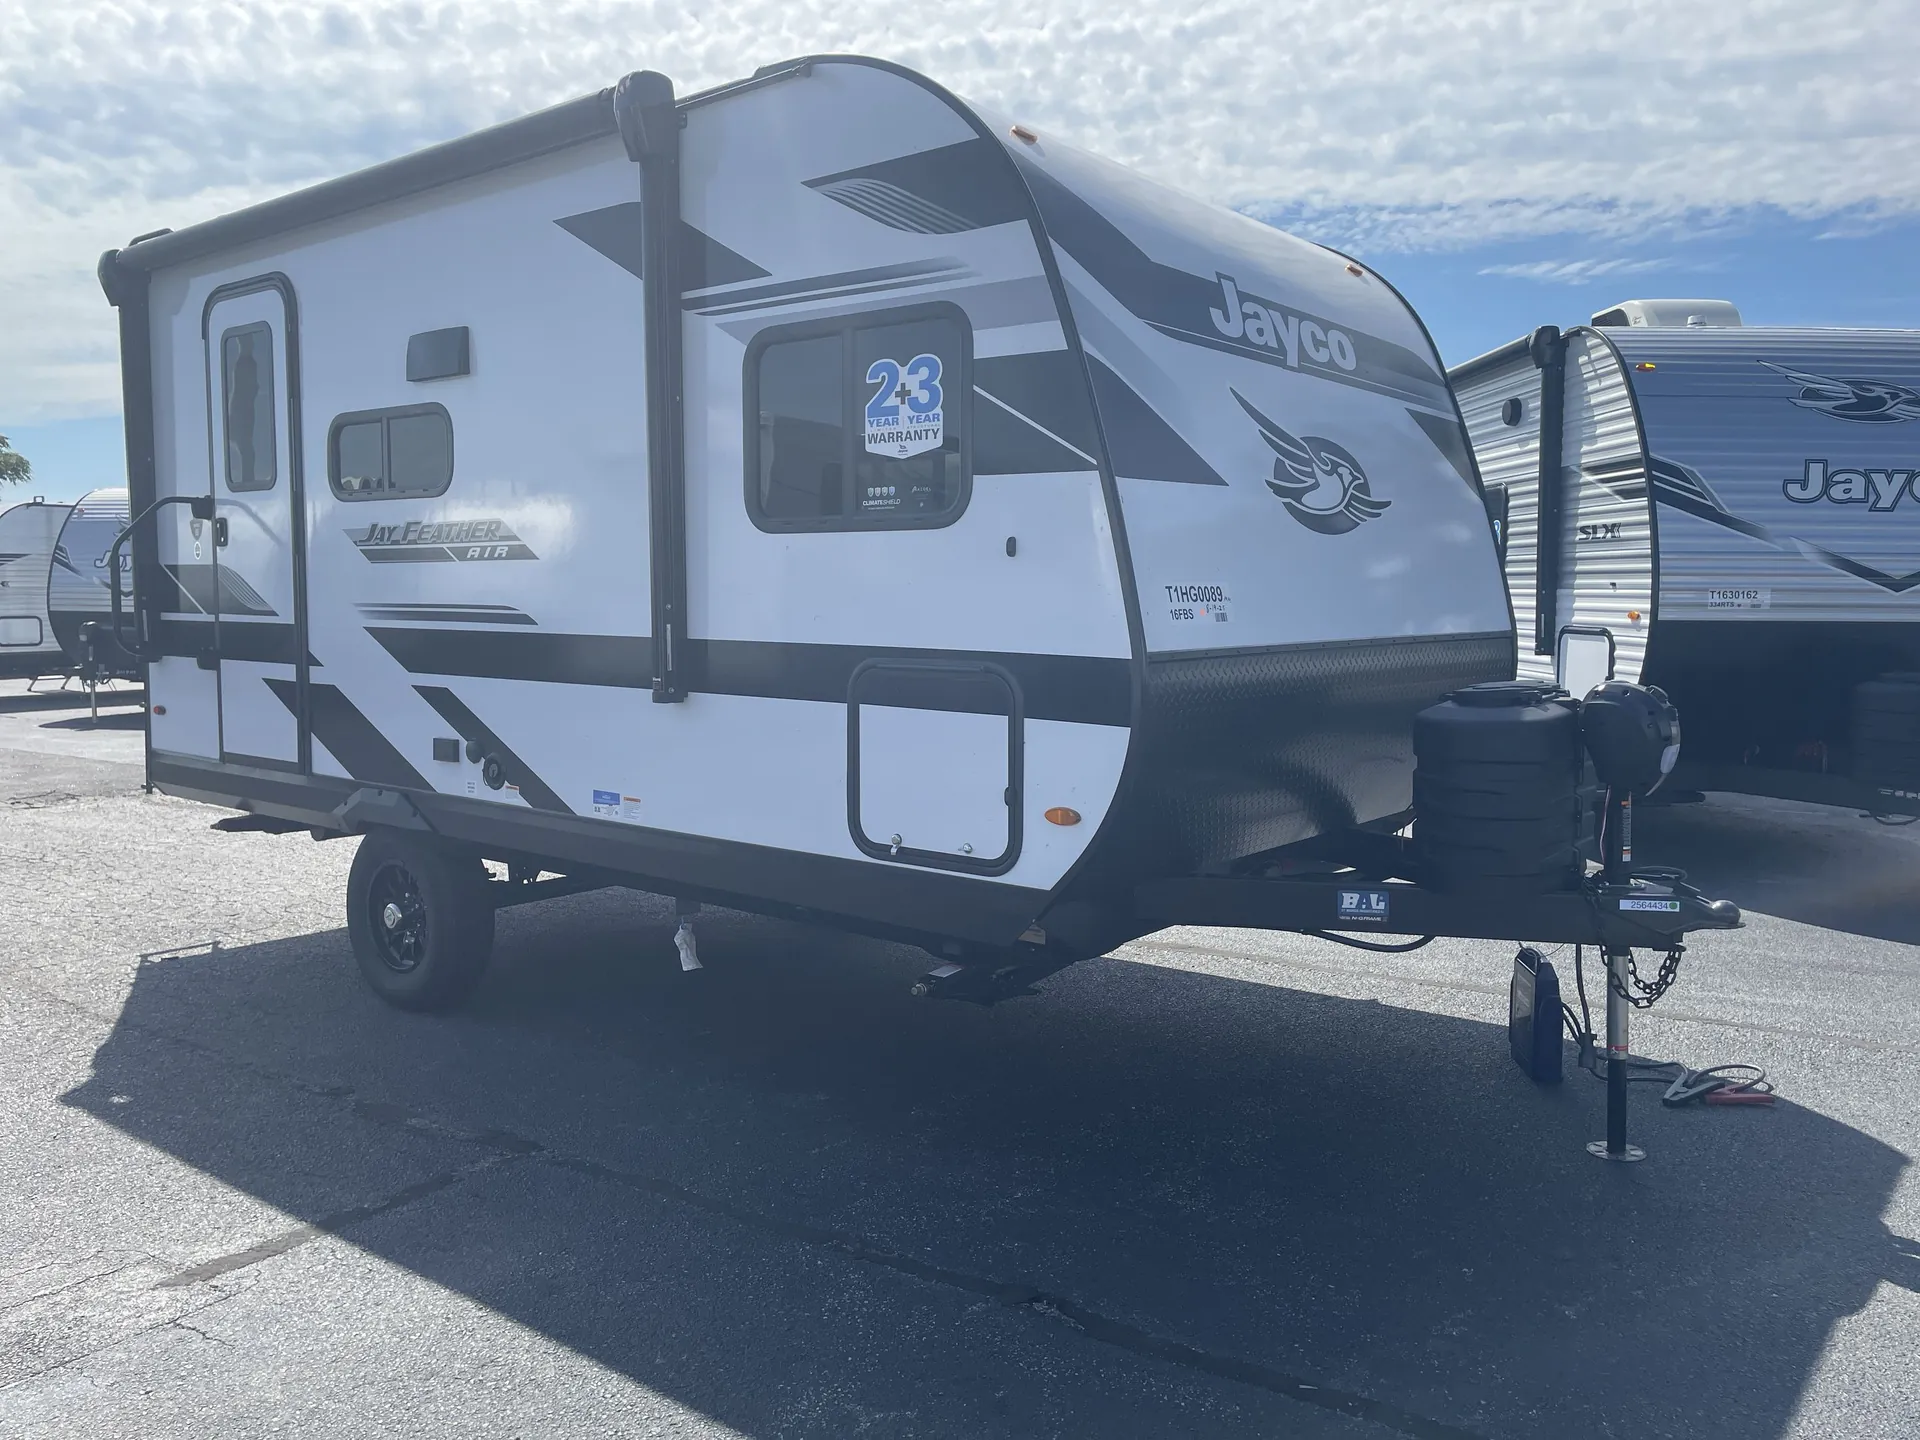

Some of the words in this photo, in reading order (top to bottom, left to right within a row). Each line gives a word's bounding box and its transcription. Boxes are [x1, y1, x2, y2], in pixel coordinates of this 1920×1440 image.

[1209, 277, 1357, 371] Jayco
[868, 417, 899, 428] YEAR
[907, 413, 940, 425] YEAR
[867, 428, 940, 444] WARRANTY
[467, 546, 509, 559] AIR
[1165, 585, 1223, 603] T1HG0089
[1709, 590, 1758, 600] T1630162
[1170, 608, 1194, 620] 16FBS
[1341, 892, 1386, 910] BAL
[1631, 901, 1668, 910] 2564434
